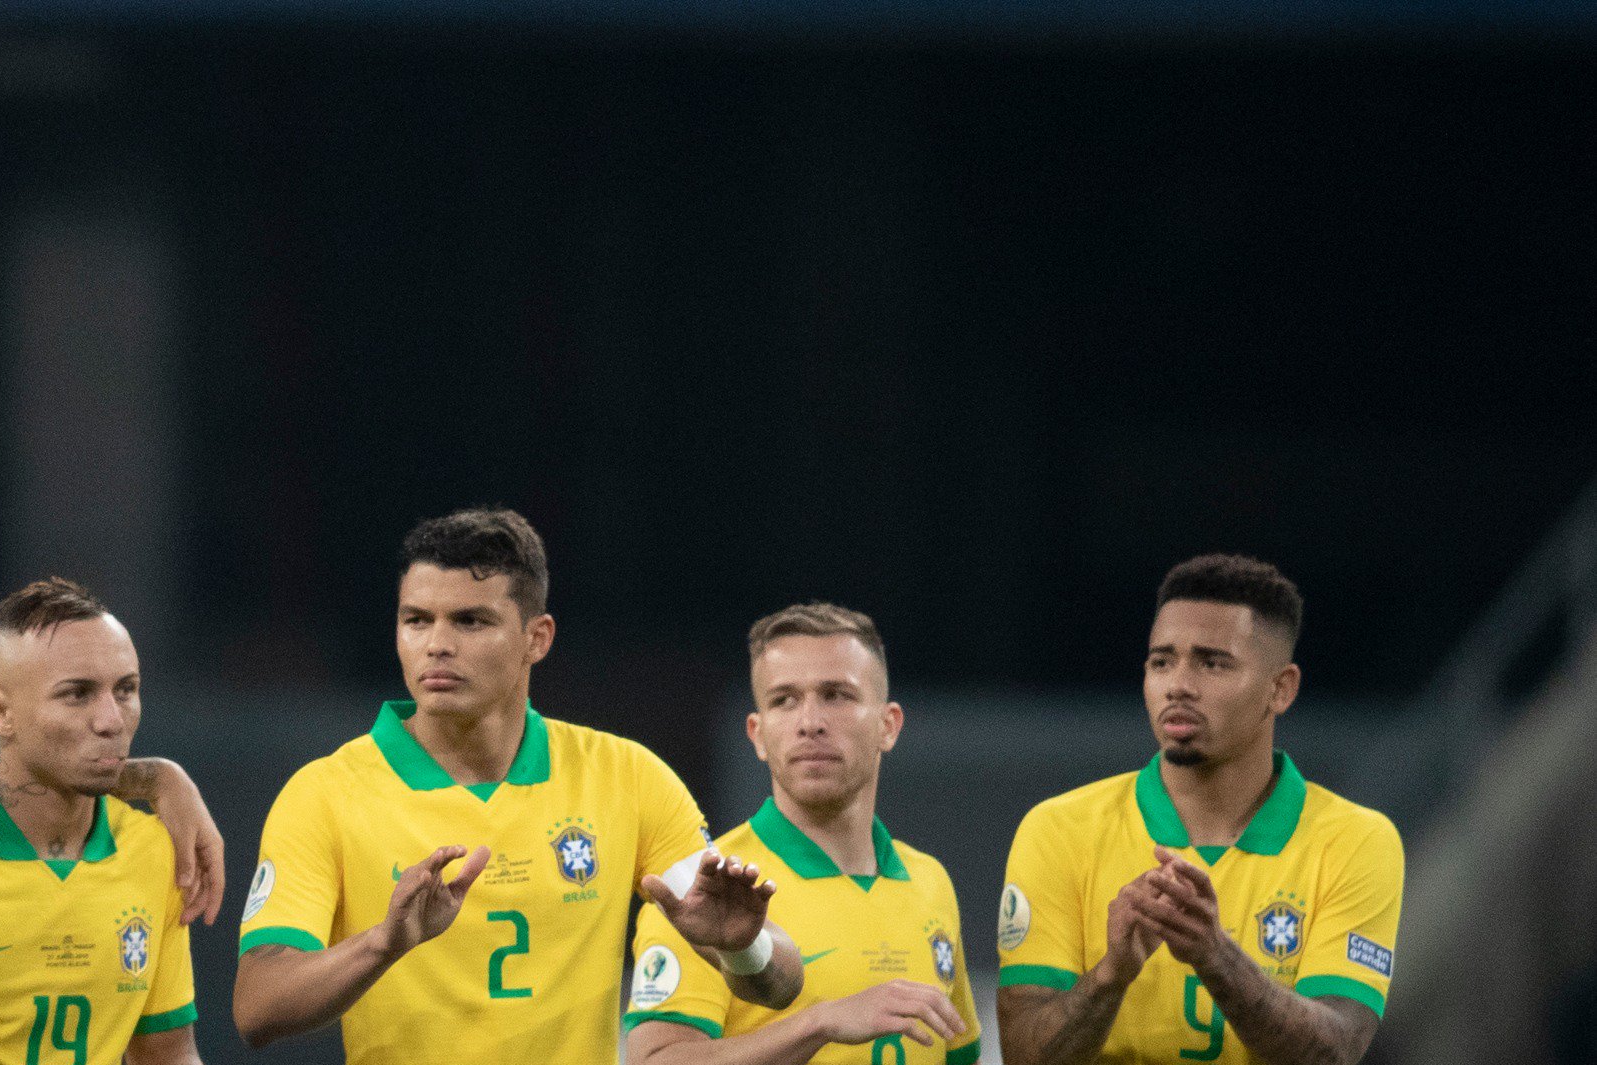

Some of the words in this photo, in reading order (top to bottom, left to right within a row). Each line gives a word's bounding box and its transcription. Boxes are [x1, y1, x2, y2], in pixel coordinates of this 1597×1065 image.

[563, 889, 599, 903] BRASIL
[486, 910, 533, 999] 2
[1179, 974, 1225, 1062] 9
